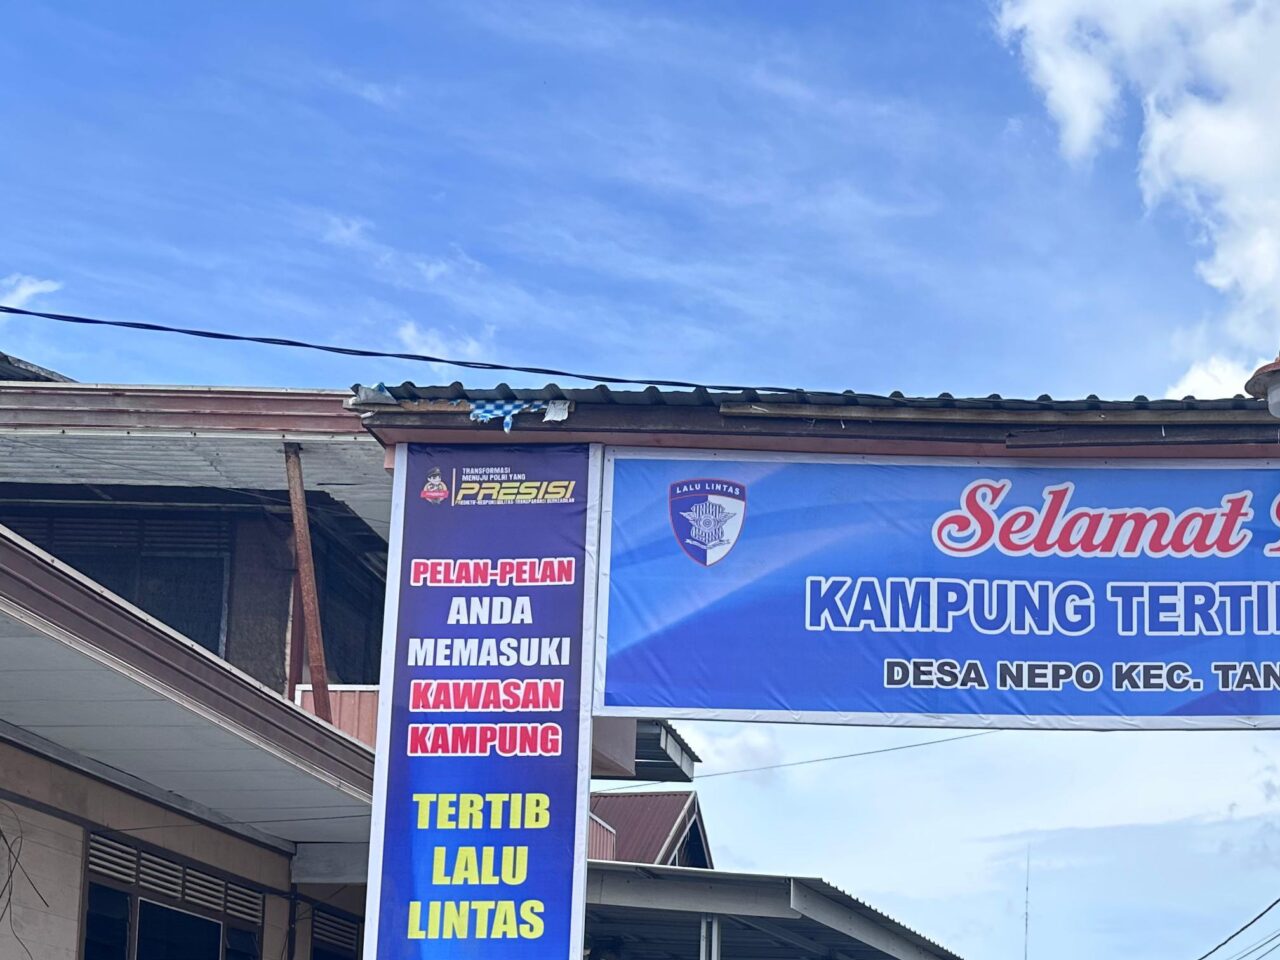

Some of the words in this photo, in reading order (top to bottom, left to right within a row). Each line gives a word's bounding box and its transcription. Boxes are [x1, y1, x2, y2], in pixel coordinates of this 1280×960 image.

[456, 481, 577, 500] PRESISI
[676, 483, 701, 494] LALU
[705, 482, 740, 496] LINTAS
[931, 478, 1254, 558] Selamat
[410, 557, 576, 587] PELAN-PELAN
[447, 596, 533, 625] ANDA
[805, 576, 1096, 636] KAMPUNG
[407, 637, 571, 666] MEMASUKI
[883, 658, 984, 689] DESA
[995, 660, 1103, 692] NEPO
[1113, 662, 1203, 692] KEC.
[409, 678, 564, 712] KAWASAN
[407, 723, 562, 757] KAMPUNG
[412, 793, 551, 830] TERTIB
[432, 846, 528, 885] LALU
[407, 899, 545, 940] LINTAS
